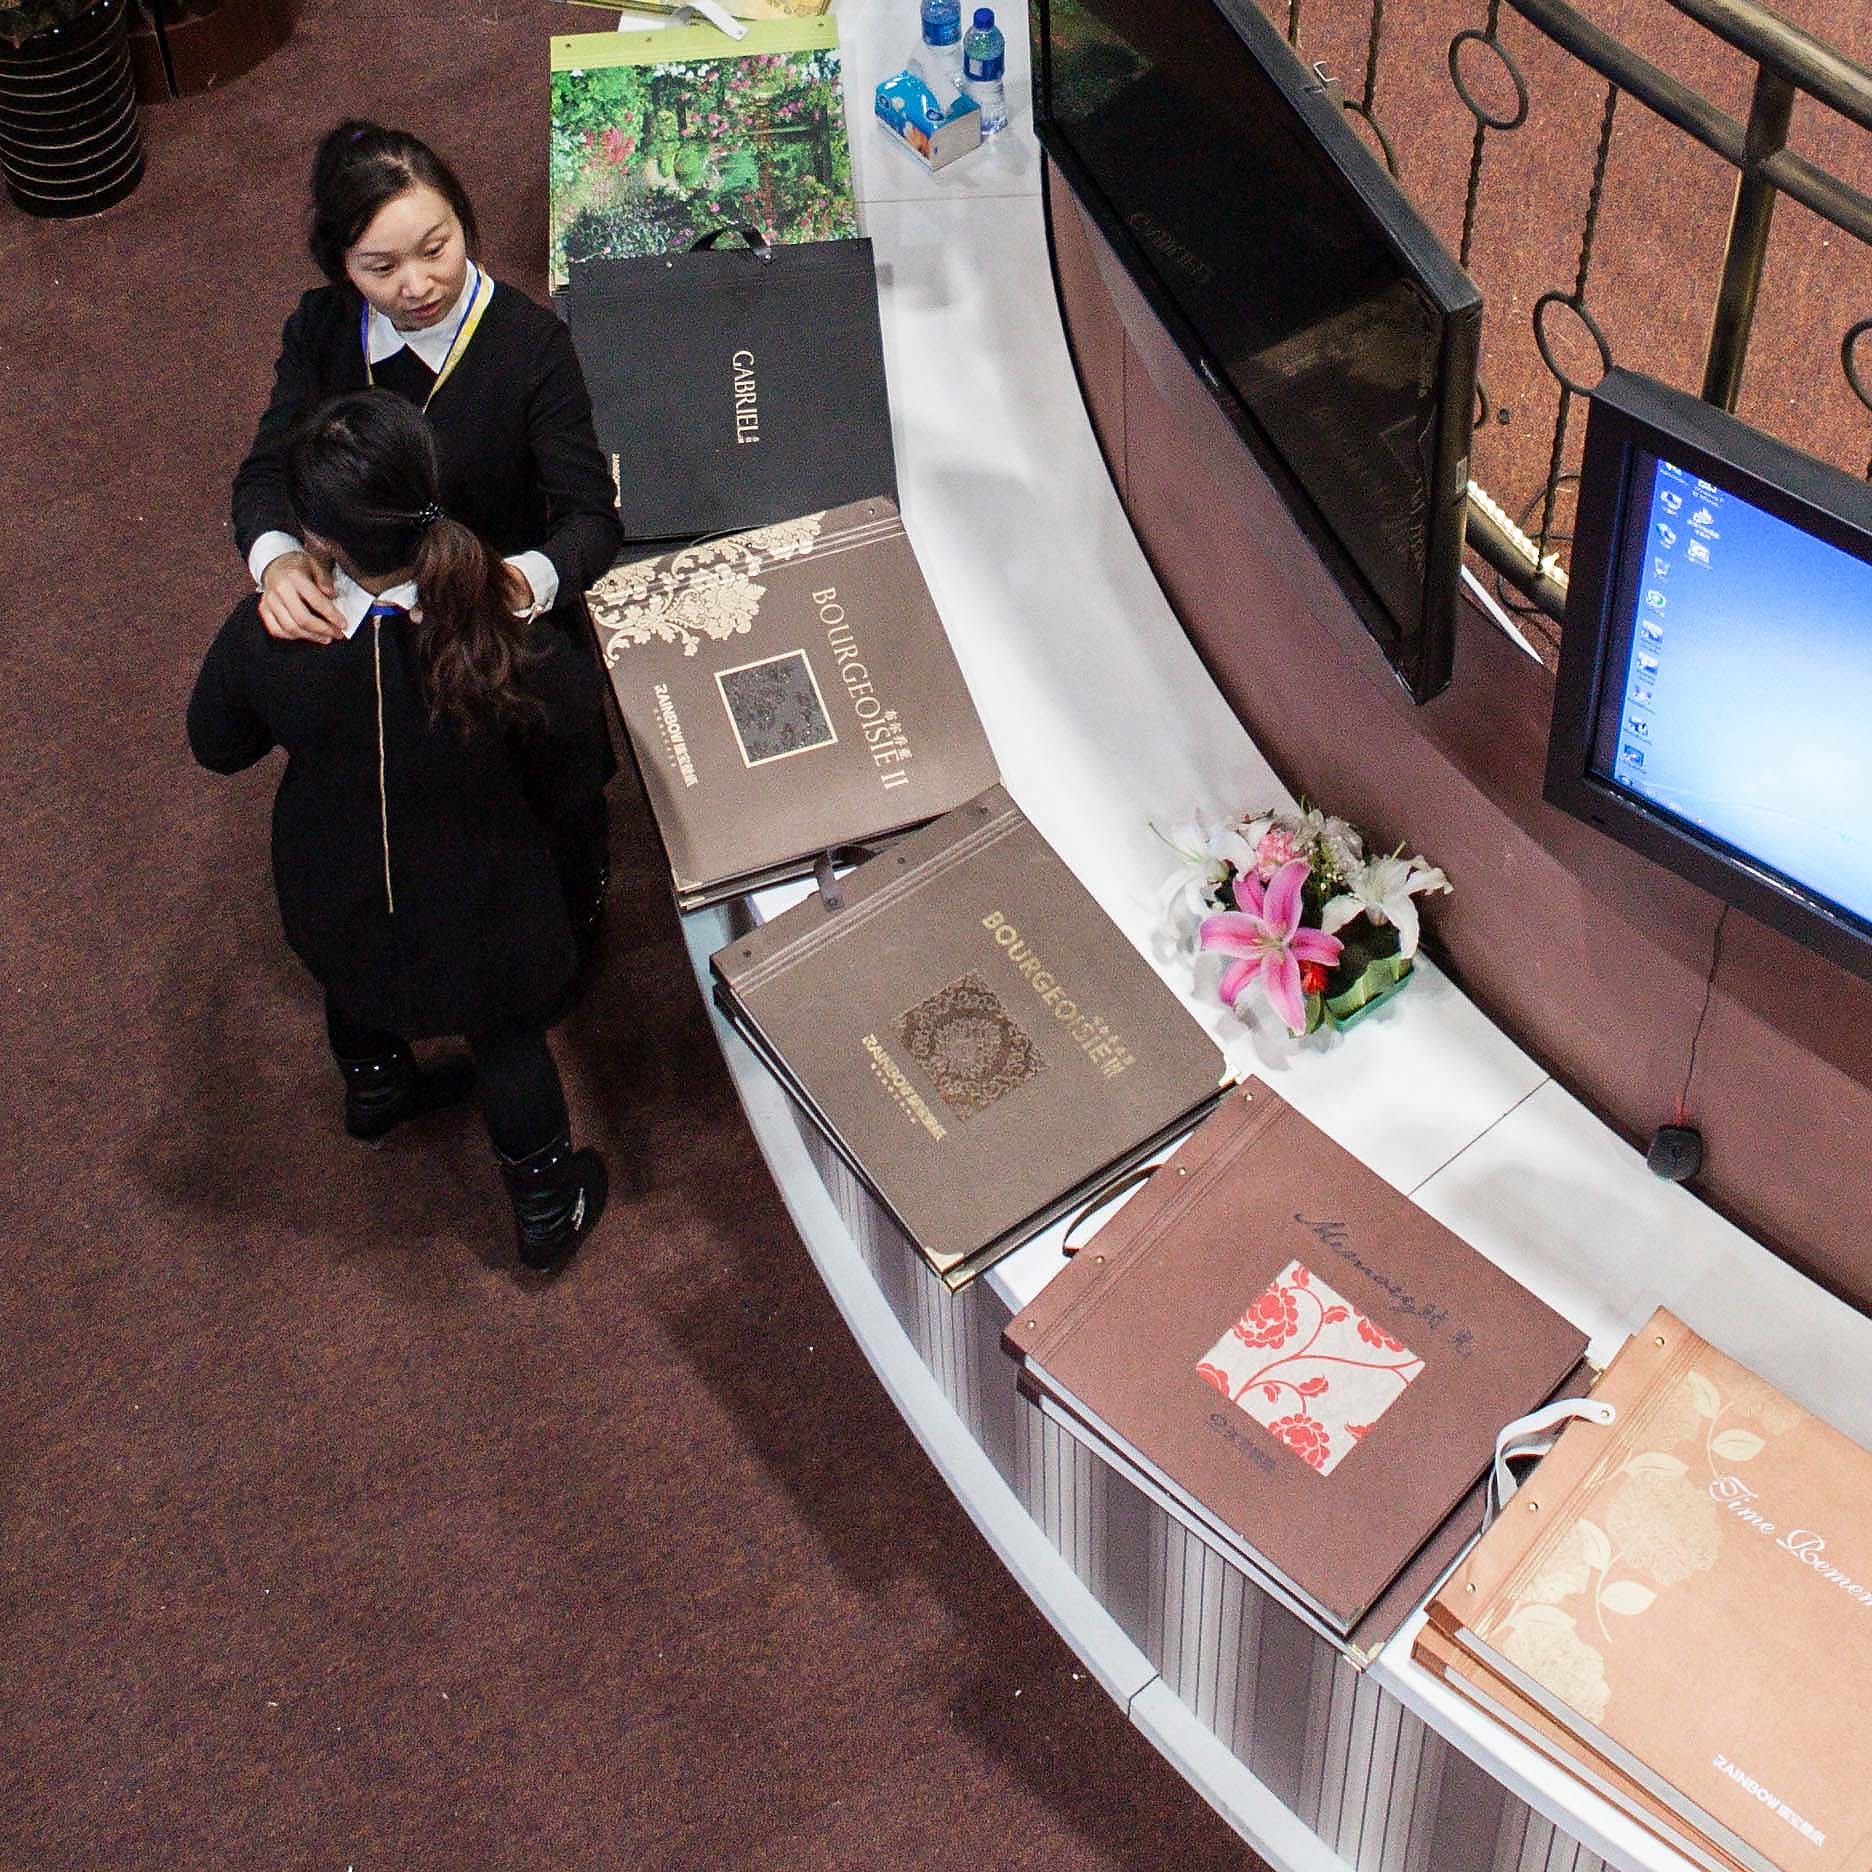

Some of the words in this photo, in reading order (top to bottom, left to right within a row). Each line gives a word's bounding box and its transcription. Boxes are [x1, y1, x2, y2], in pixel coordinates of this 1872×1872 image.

[811, 586, 899, 768] BOURGEOISIE
[981, 909, 1113, 1065] BOURGEOISIE
[1709, 1477, 1776, 1537] Time
